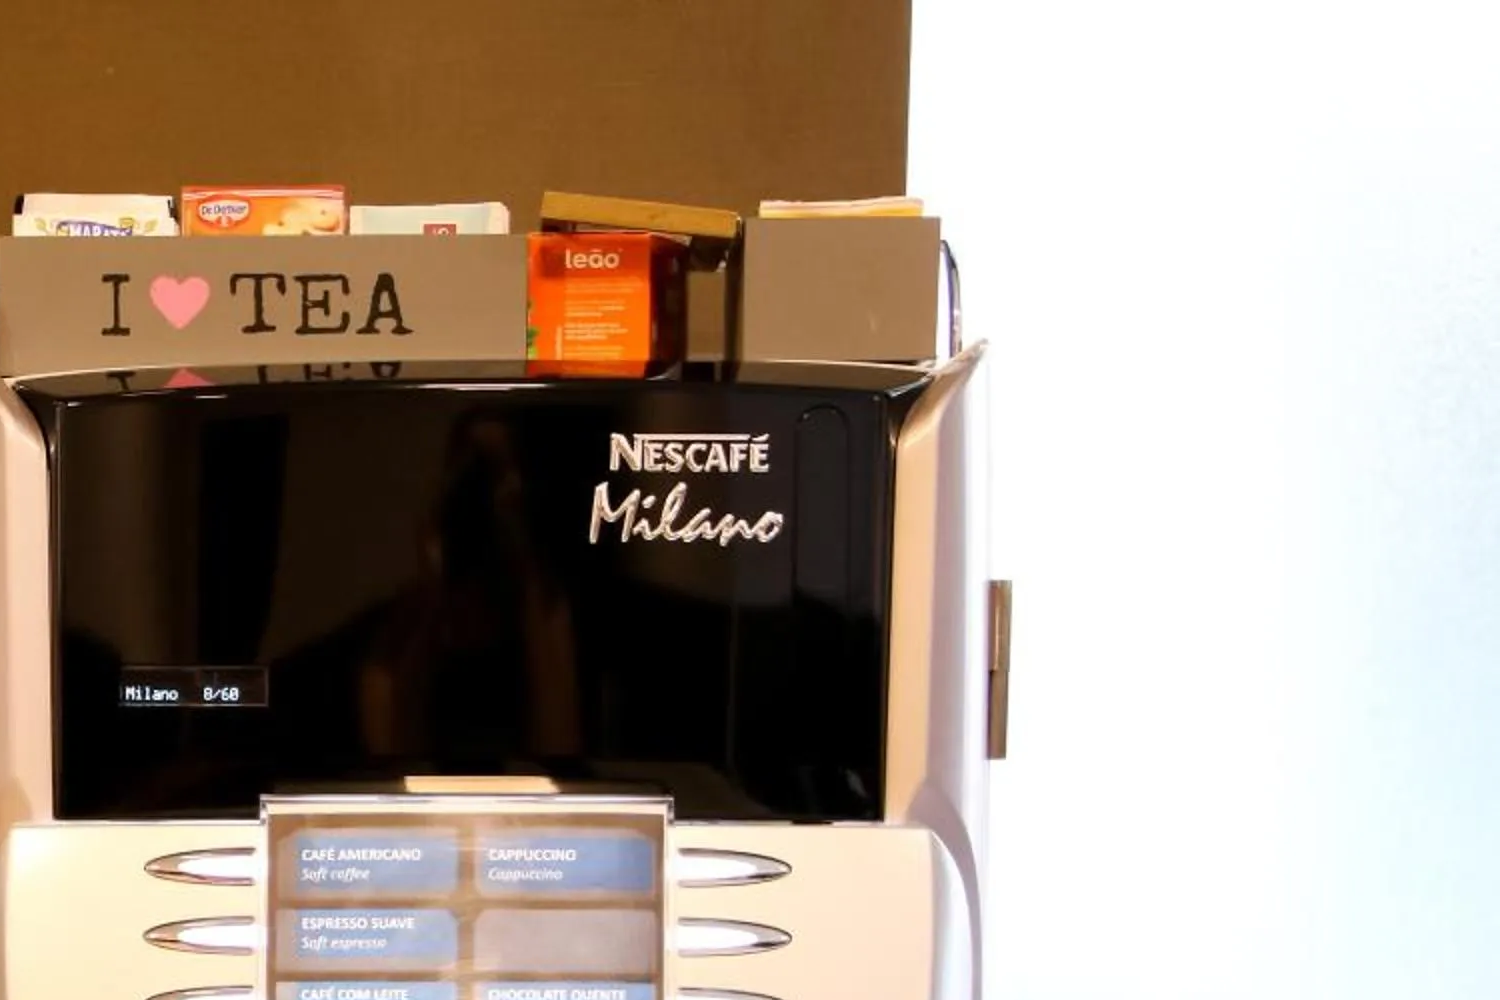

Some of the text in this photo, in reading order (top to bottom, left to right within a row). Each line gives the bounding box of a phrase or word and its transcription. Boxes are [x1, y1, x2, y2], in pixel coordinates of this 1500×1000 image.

[565, 248, 620, 270] leão
[101, 272, 414, 337] I TEA
[609, 432, 770, 472] NESCAFÉ
[589, 481, 784, 547] Milano
[125, 684, 179, 701] Milano
[301, 846, 422, 861] CAFÉ AMERICANO
[488, 847, 577, 861] CAPPUCCINO
[301, 867, 370, 882] Soft coffee
[488, 867, 563, 883] Cappuccino
[301, 917, 415, 930] ESPRESSO SUAVE
[301, 936, 387, 951] Soft espresso
[301, 986, 409, 1000] CAFÉ COM LEITE
